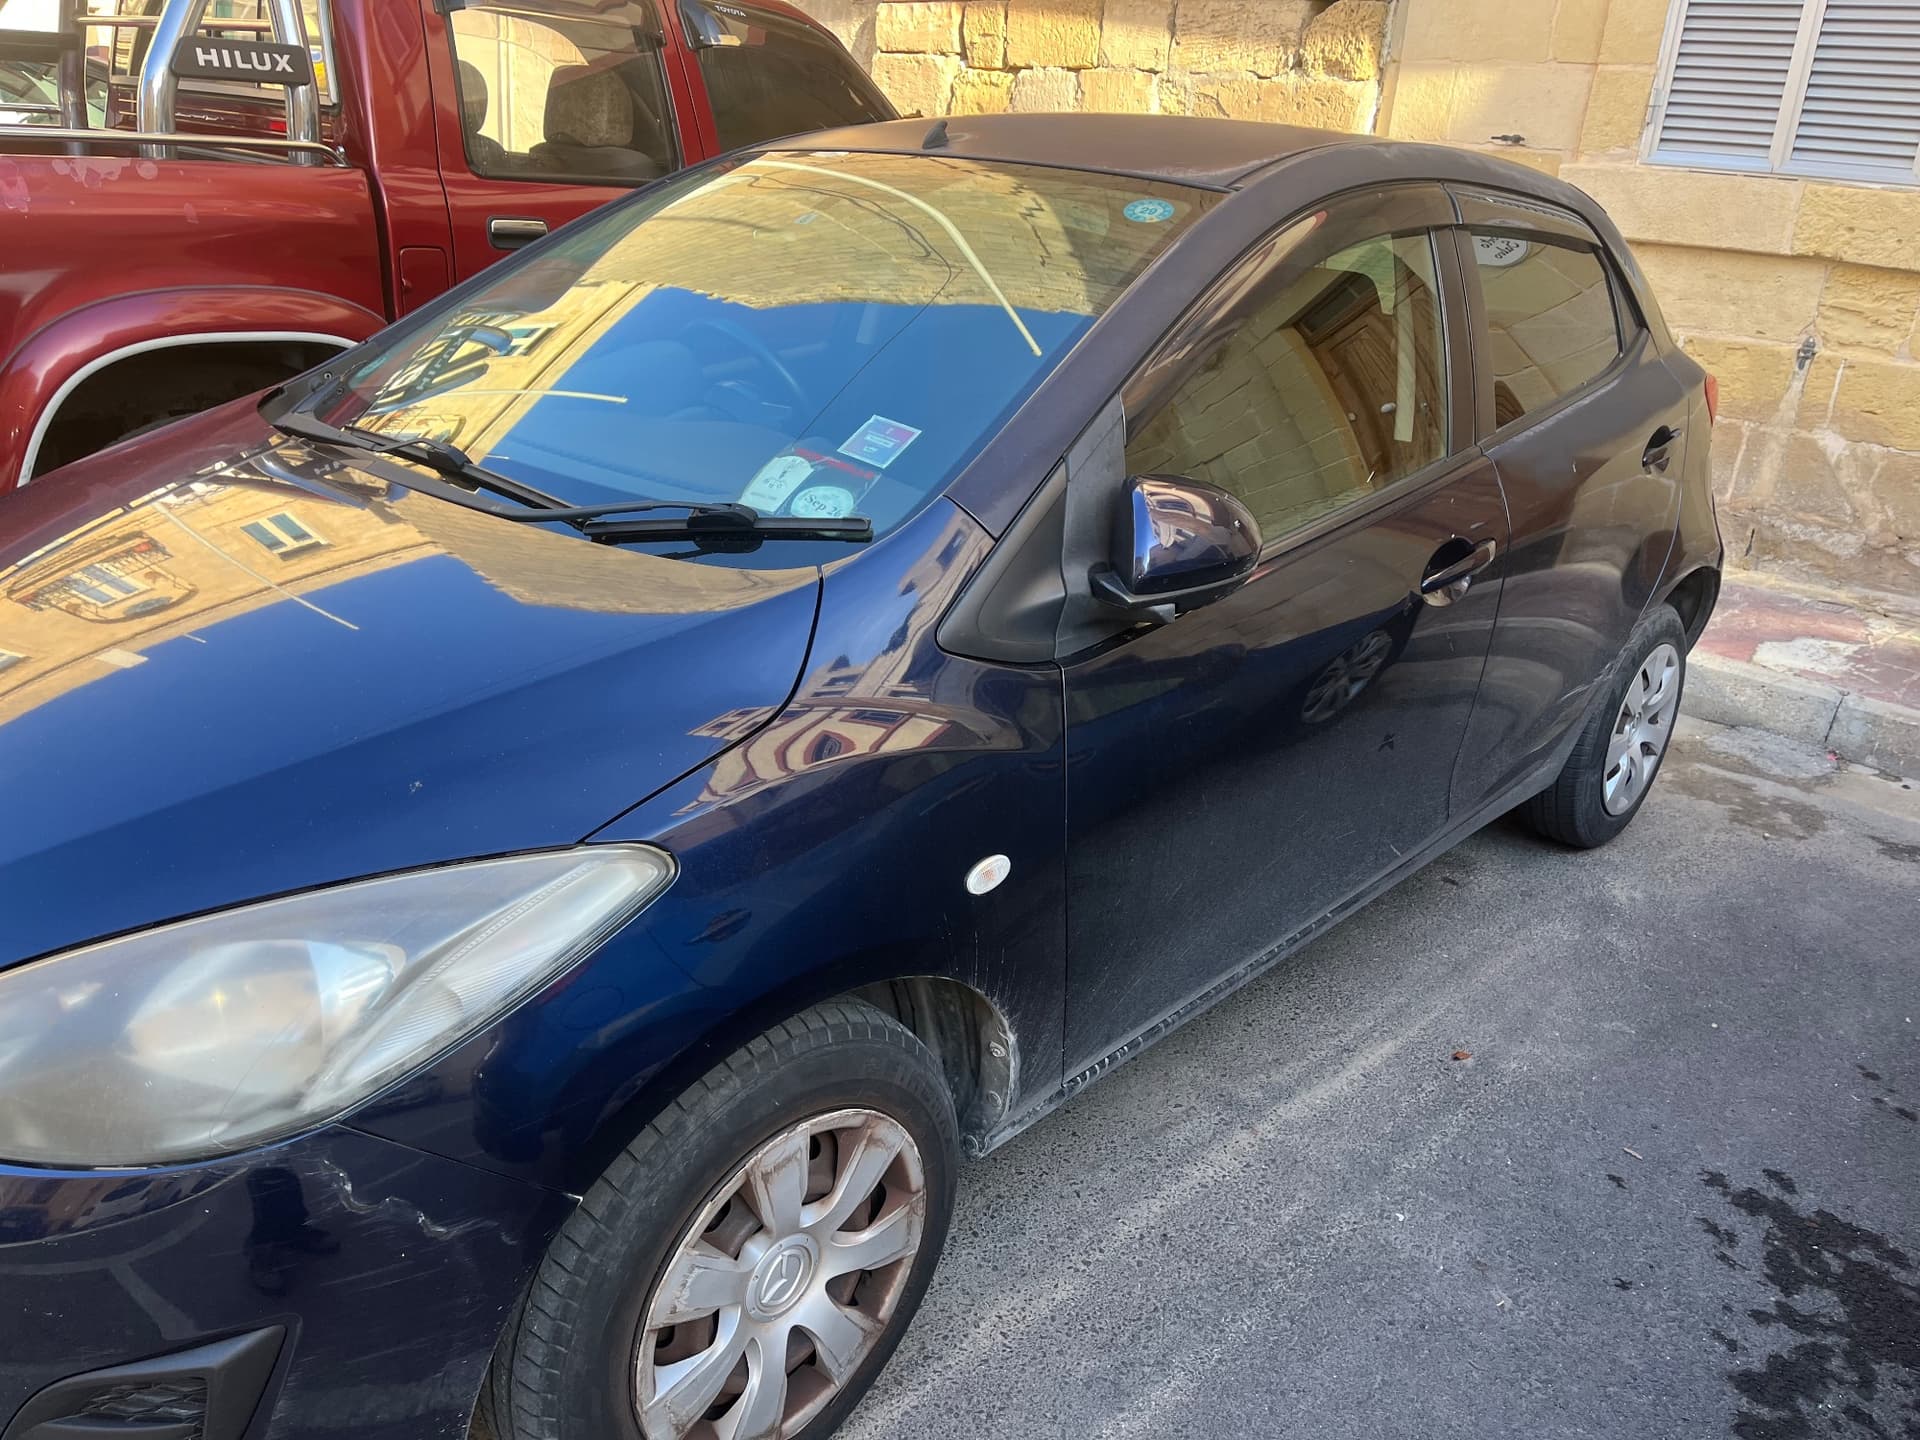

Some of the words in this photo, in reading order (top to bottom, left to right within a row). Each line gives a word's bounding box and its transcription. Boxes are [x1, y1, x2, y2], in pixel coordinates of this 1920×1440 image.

[714, 5, 746, 17] TOYOTA
[195, 47, 295, 73] HILUX
[804, 494, 827, 511] Sep
